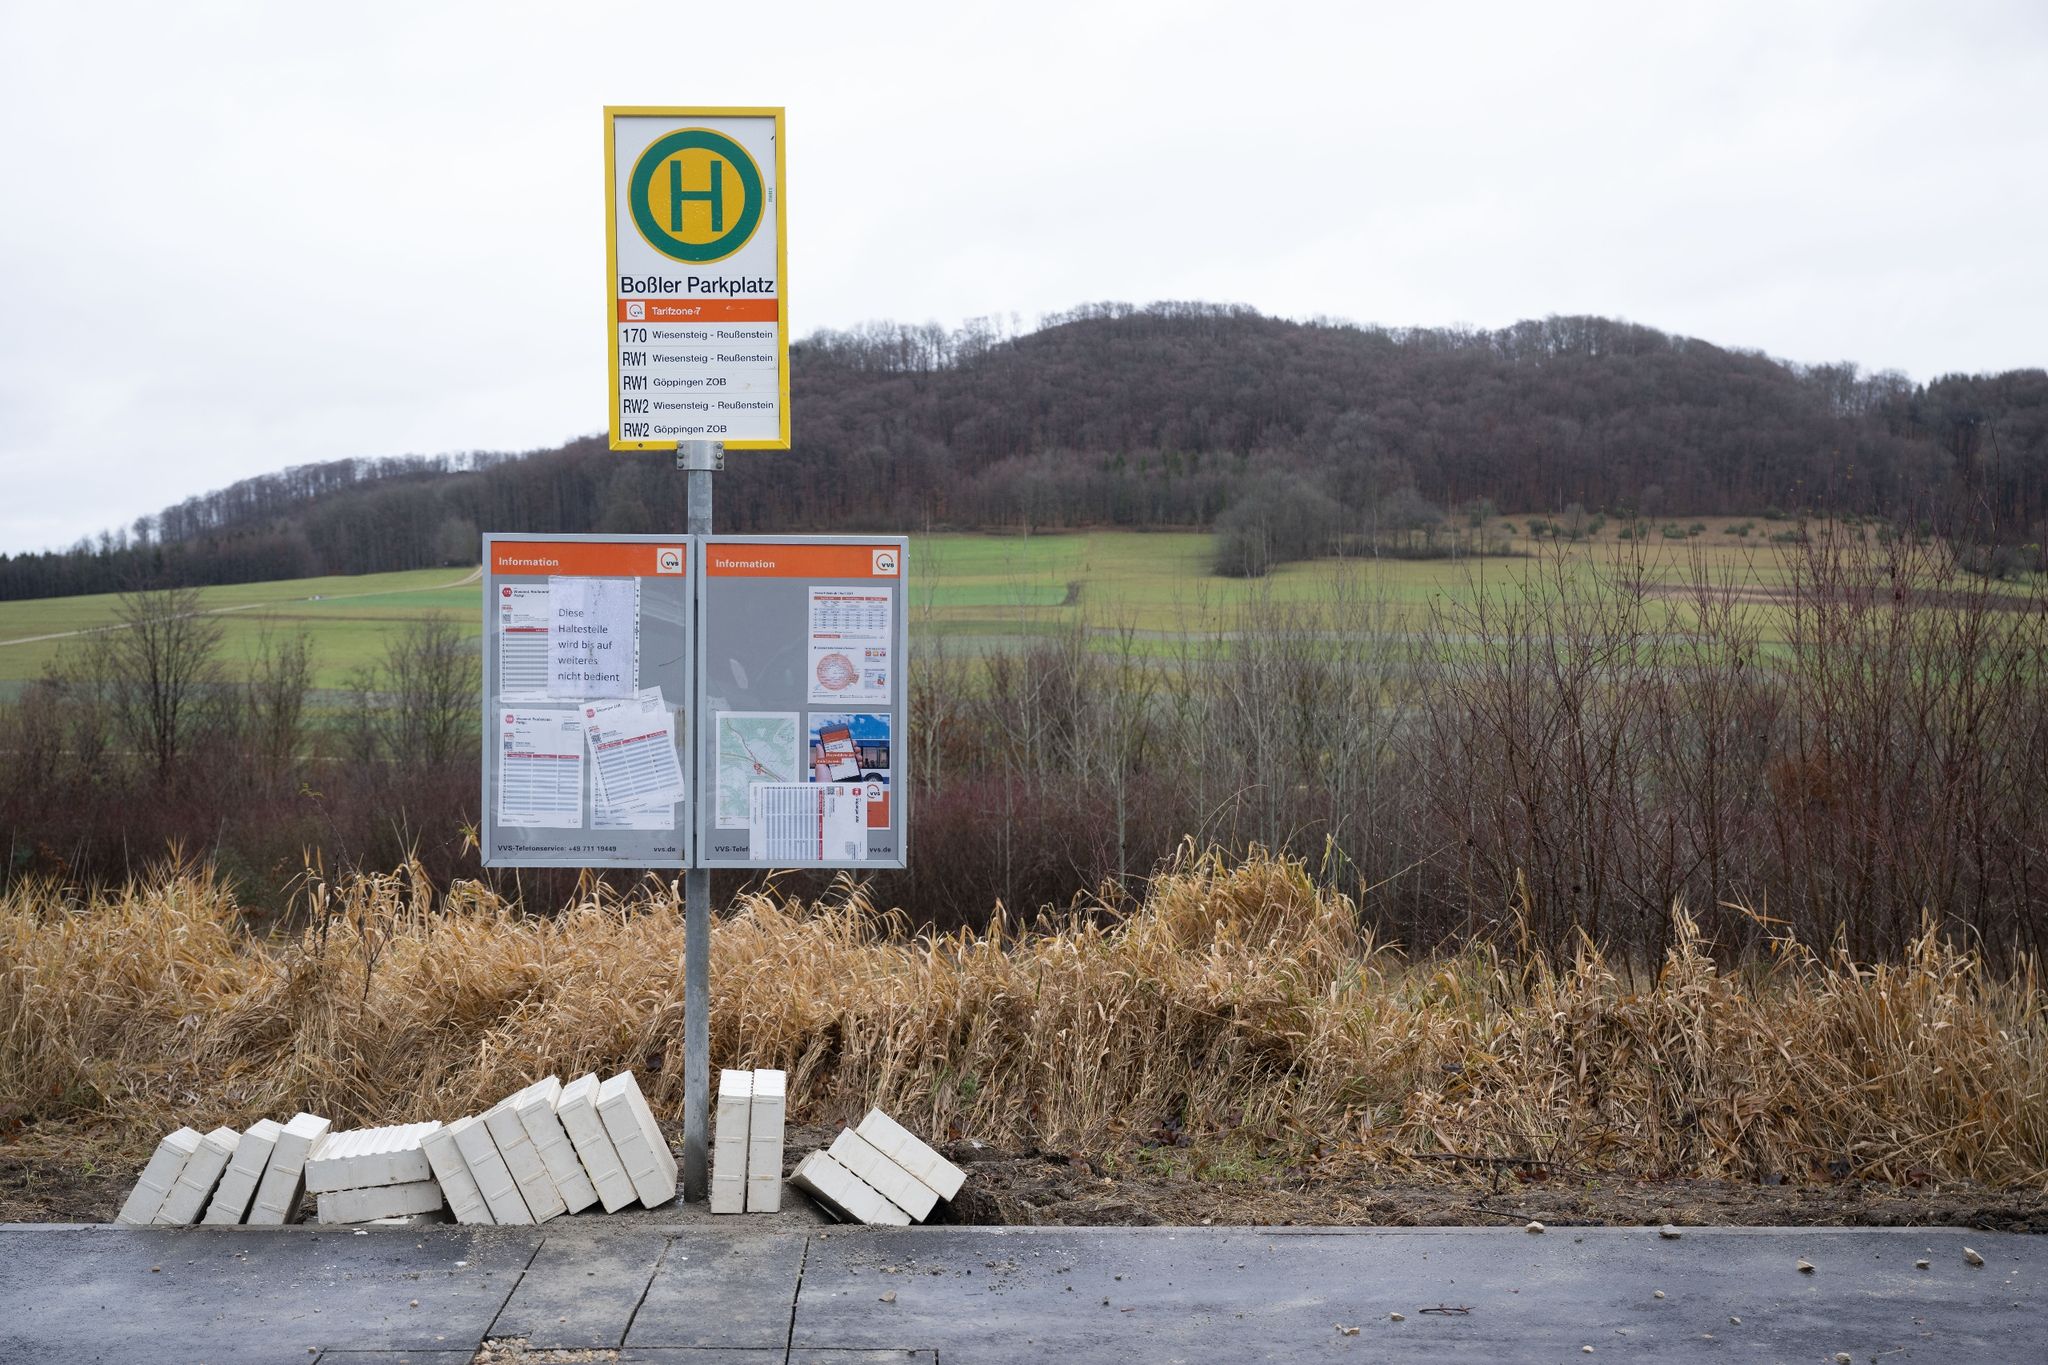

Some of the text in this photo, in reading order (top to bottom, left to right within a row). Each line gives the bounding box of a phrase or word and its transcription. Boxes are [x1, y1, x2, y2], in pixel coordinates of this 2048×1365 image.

[670, 160, 723, 232] H
[621, 276, 775, 297] Boßler Parkplatz
[652, 306, 693, 316] Tarifzone
[623, 328, 647, 343] 170
[652, 330, 708, 340] Wiesensteig
[717, 330, 773, 339] Reußenstein
[622, 351, 647, 366] RW1
[652, 354, 708, 363] Wiesensteig
[717, 353, 773, 362] Reußenstein
[623, 375, 727, 390] RW1 Göppingen ZOB
[623, 398, 649, 414] RW2
[653, 401, 709, 411] Wiesensteig
[718, 401, 774, 409] Reußenstein
[624, 422, 727, 437] RW2 Göppingen ZOB
[498, 556, 559, 567] Information
[715, 559, 776, 569] Information
[558, 608, 584, 618] Diese
[558, 624, 608, 634] Haltestelle
[558, 640, 613, 650] wird bis auf
[558, 655, 598, 665] weiteres
[558, 671, 620, 682] nicht bedient
